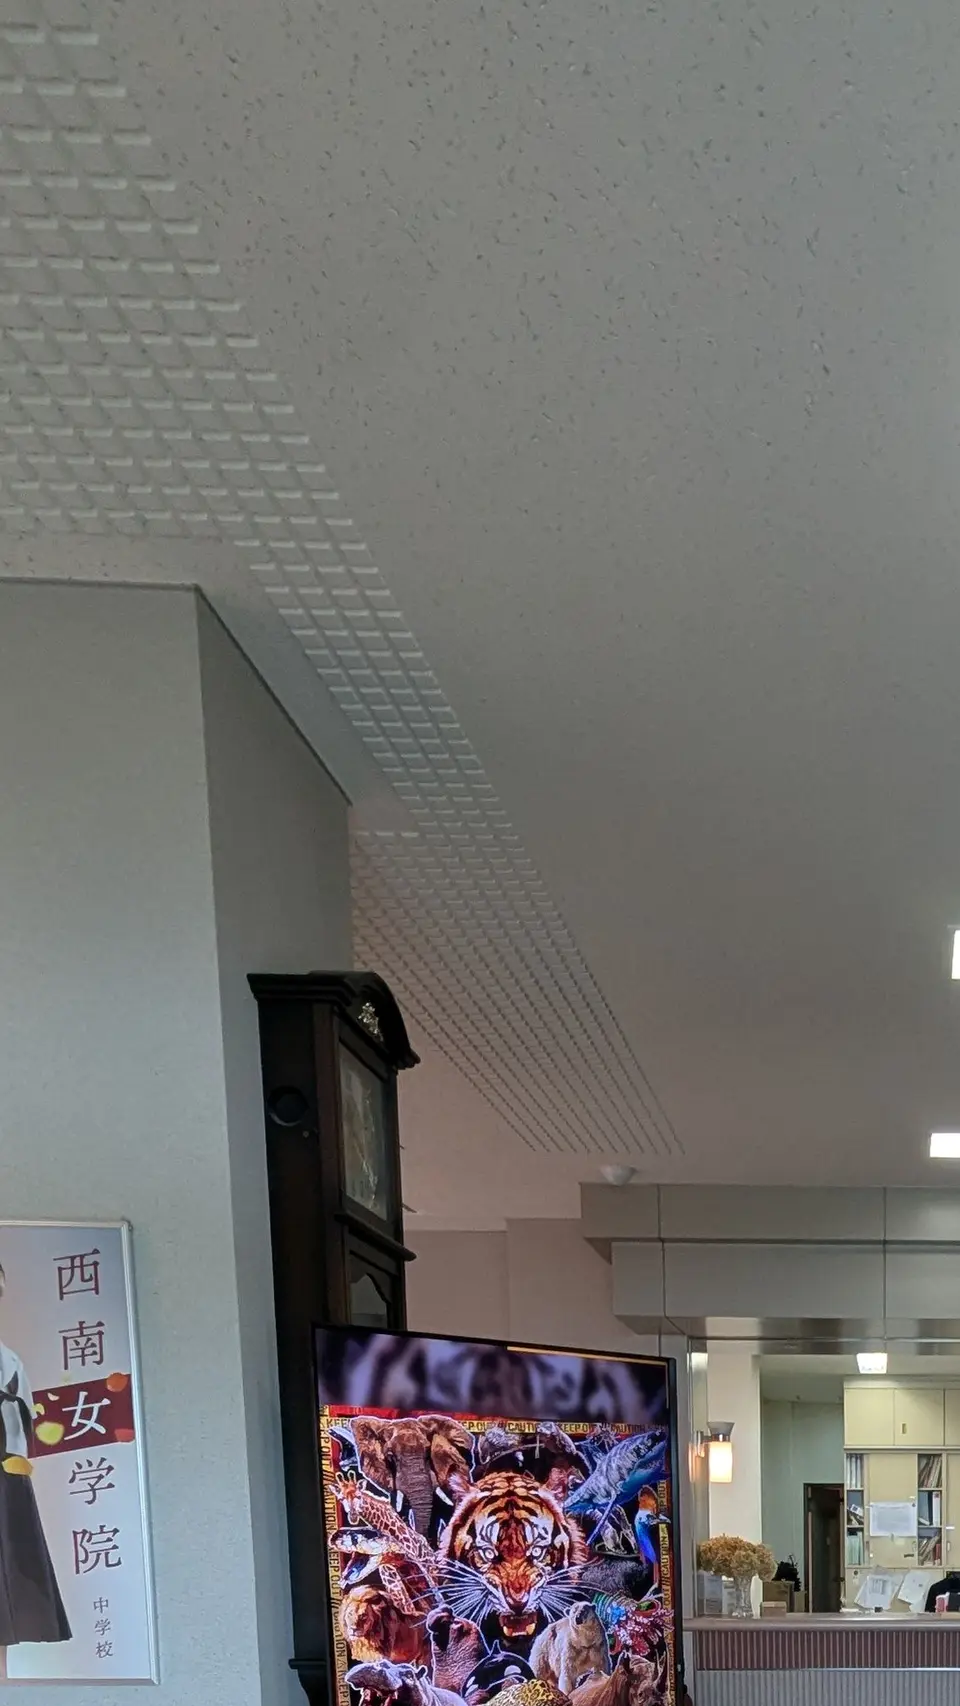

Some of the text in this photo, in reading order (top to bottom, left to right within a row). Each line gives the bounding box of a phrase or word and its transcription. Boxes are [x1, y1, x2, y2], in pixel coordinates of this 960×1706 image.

[53, 1249, 122, 1575] 西南女学院
[93, 1597, 114, 1659] 中学校
